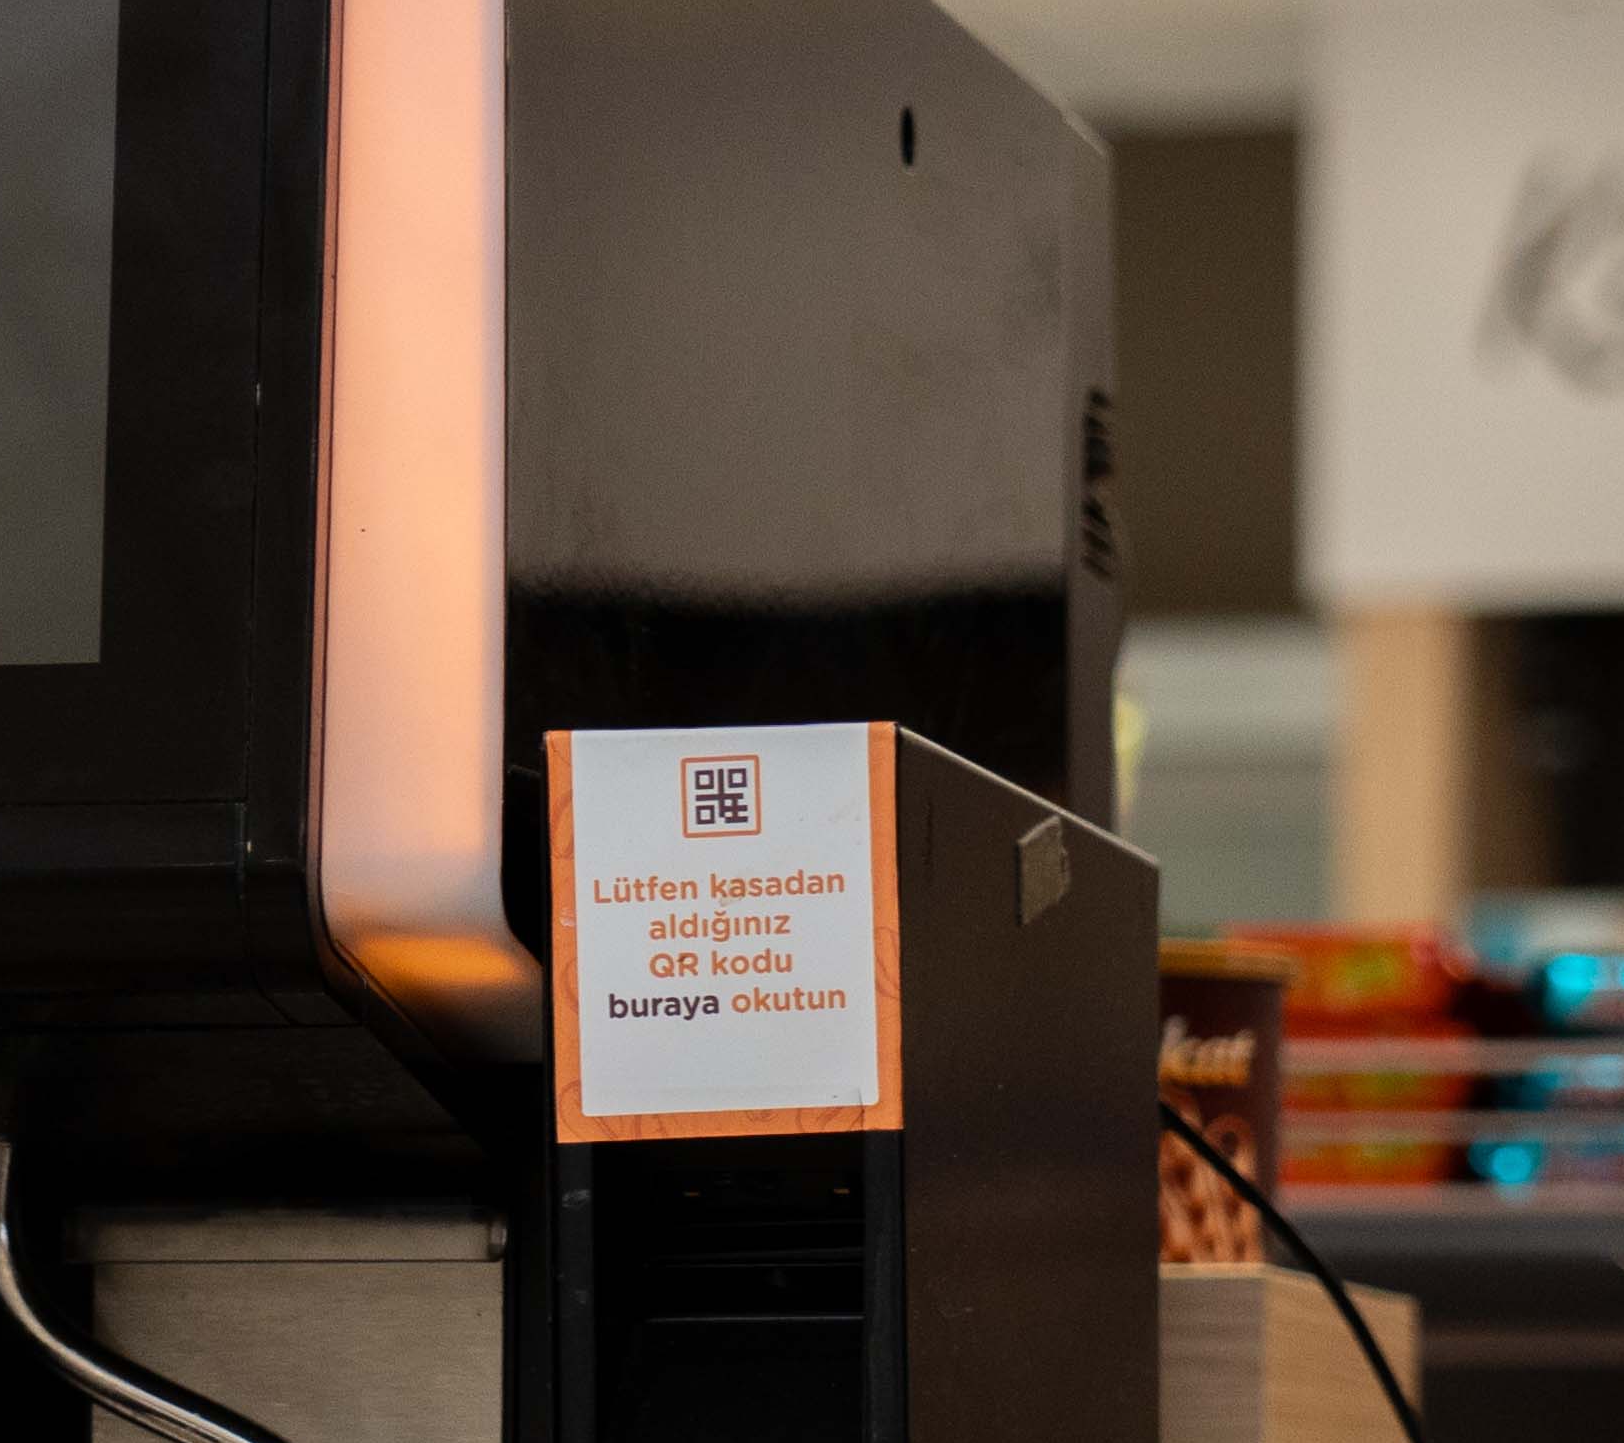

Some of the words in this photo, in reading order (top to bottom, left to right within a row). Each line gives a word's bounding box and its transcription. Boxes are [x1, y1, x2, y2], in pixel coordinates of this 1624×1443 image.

[593, 875, 698, 904] Lütfen
[709, 869, 845, 899] kasadan
[649, 911, 791, 944] aldığınız
[649, 951, 699, 979] QR
[711, 948, 793, 976] kodu
[609, 993, 720, 1020] buraya
[731, 986, 846, 1014] okutun
